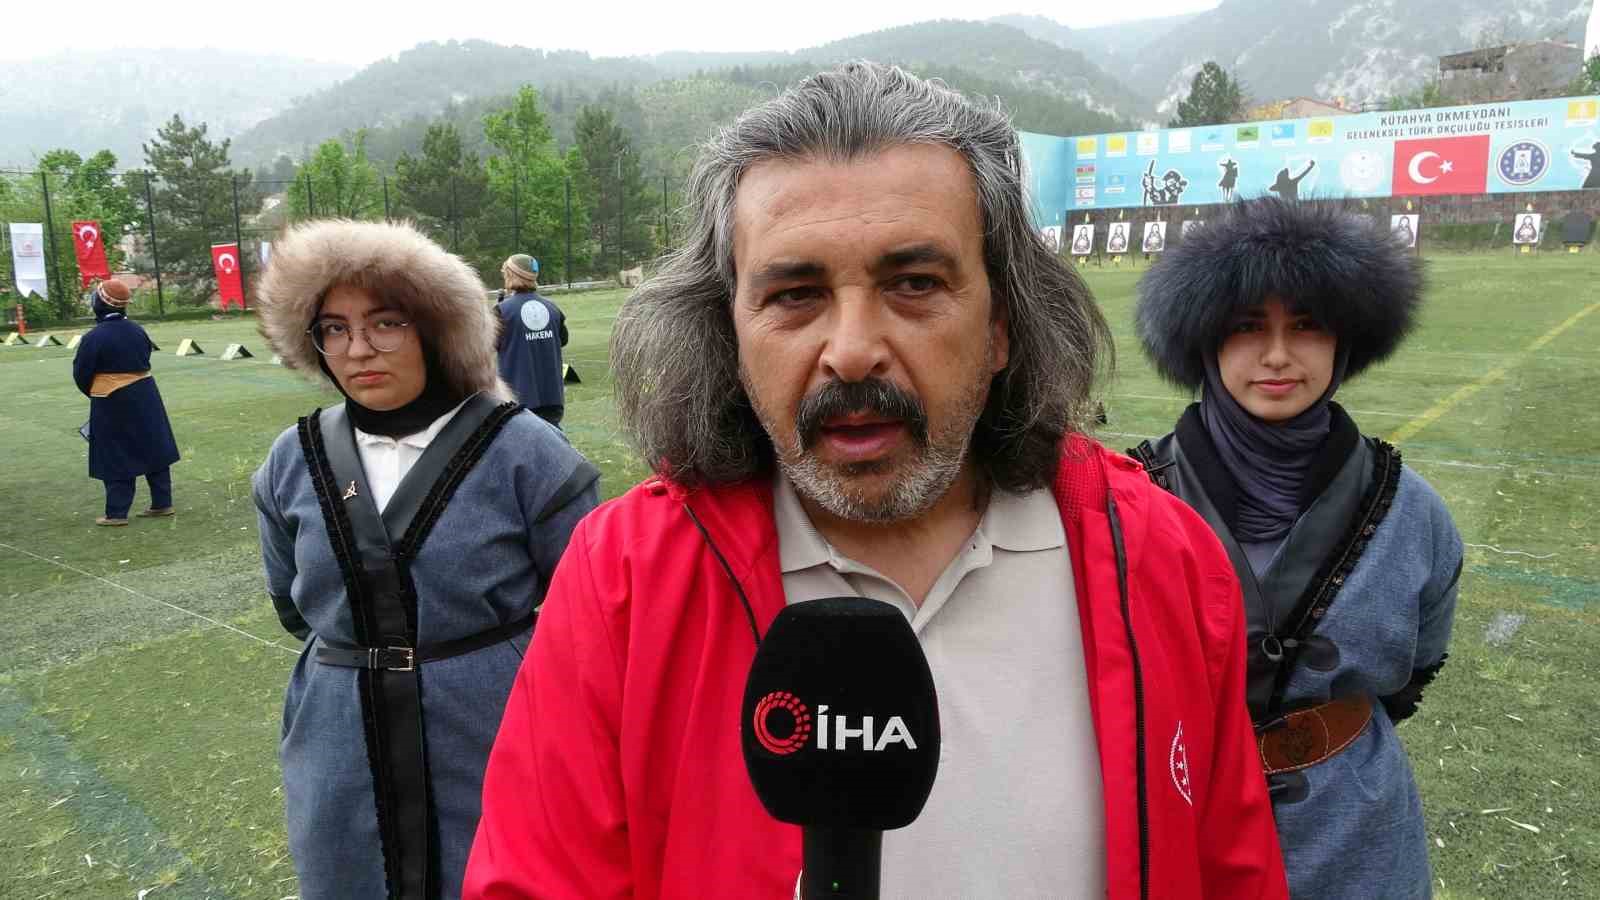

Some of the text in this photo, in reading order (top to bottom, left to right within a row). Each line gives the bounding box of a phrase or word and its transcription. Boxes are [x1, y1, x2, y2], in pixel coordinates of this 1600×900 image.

[1380, 107, 1512, 127] KÜTAHYA OKMEYDANI
[1346, 128, 1404, 140] GELENEKSEL
[1408, 125, 1433, 136] TÜRK
[1437, 121, 1490, 134] OKÇULUĞU
[525, 330, 553, 341] HAKEM
[816, 704, 918, 752] İHA
